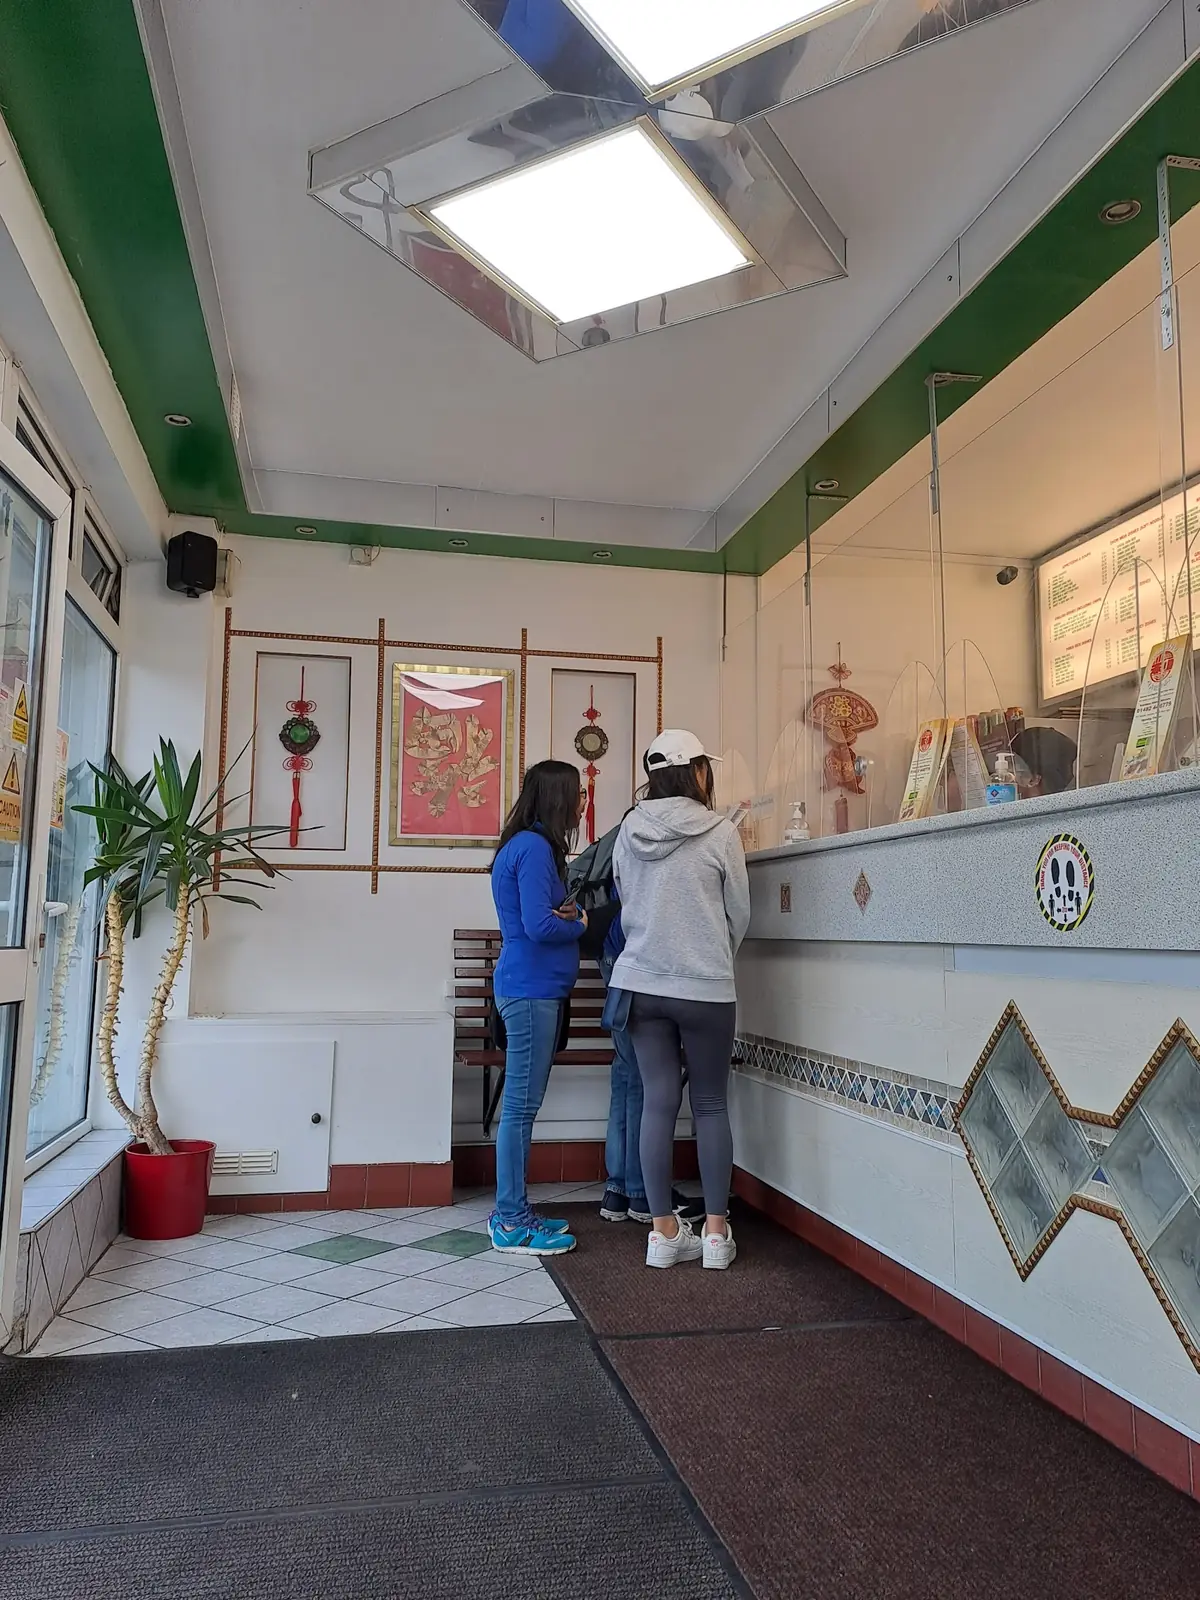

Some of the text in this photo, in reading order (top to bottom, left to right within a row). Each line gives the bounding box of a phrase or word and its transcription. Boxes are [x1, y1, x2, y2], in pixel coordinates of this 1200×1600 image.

[1047, 847, 1055, 859] FOR
[1054, 843, 1070, 852] KEEPING
[1070, 844, 1081, 860] YOUR
[1078, 856, 1089, 889] DISTANCE
